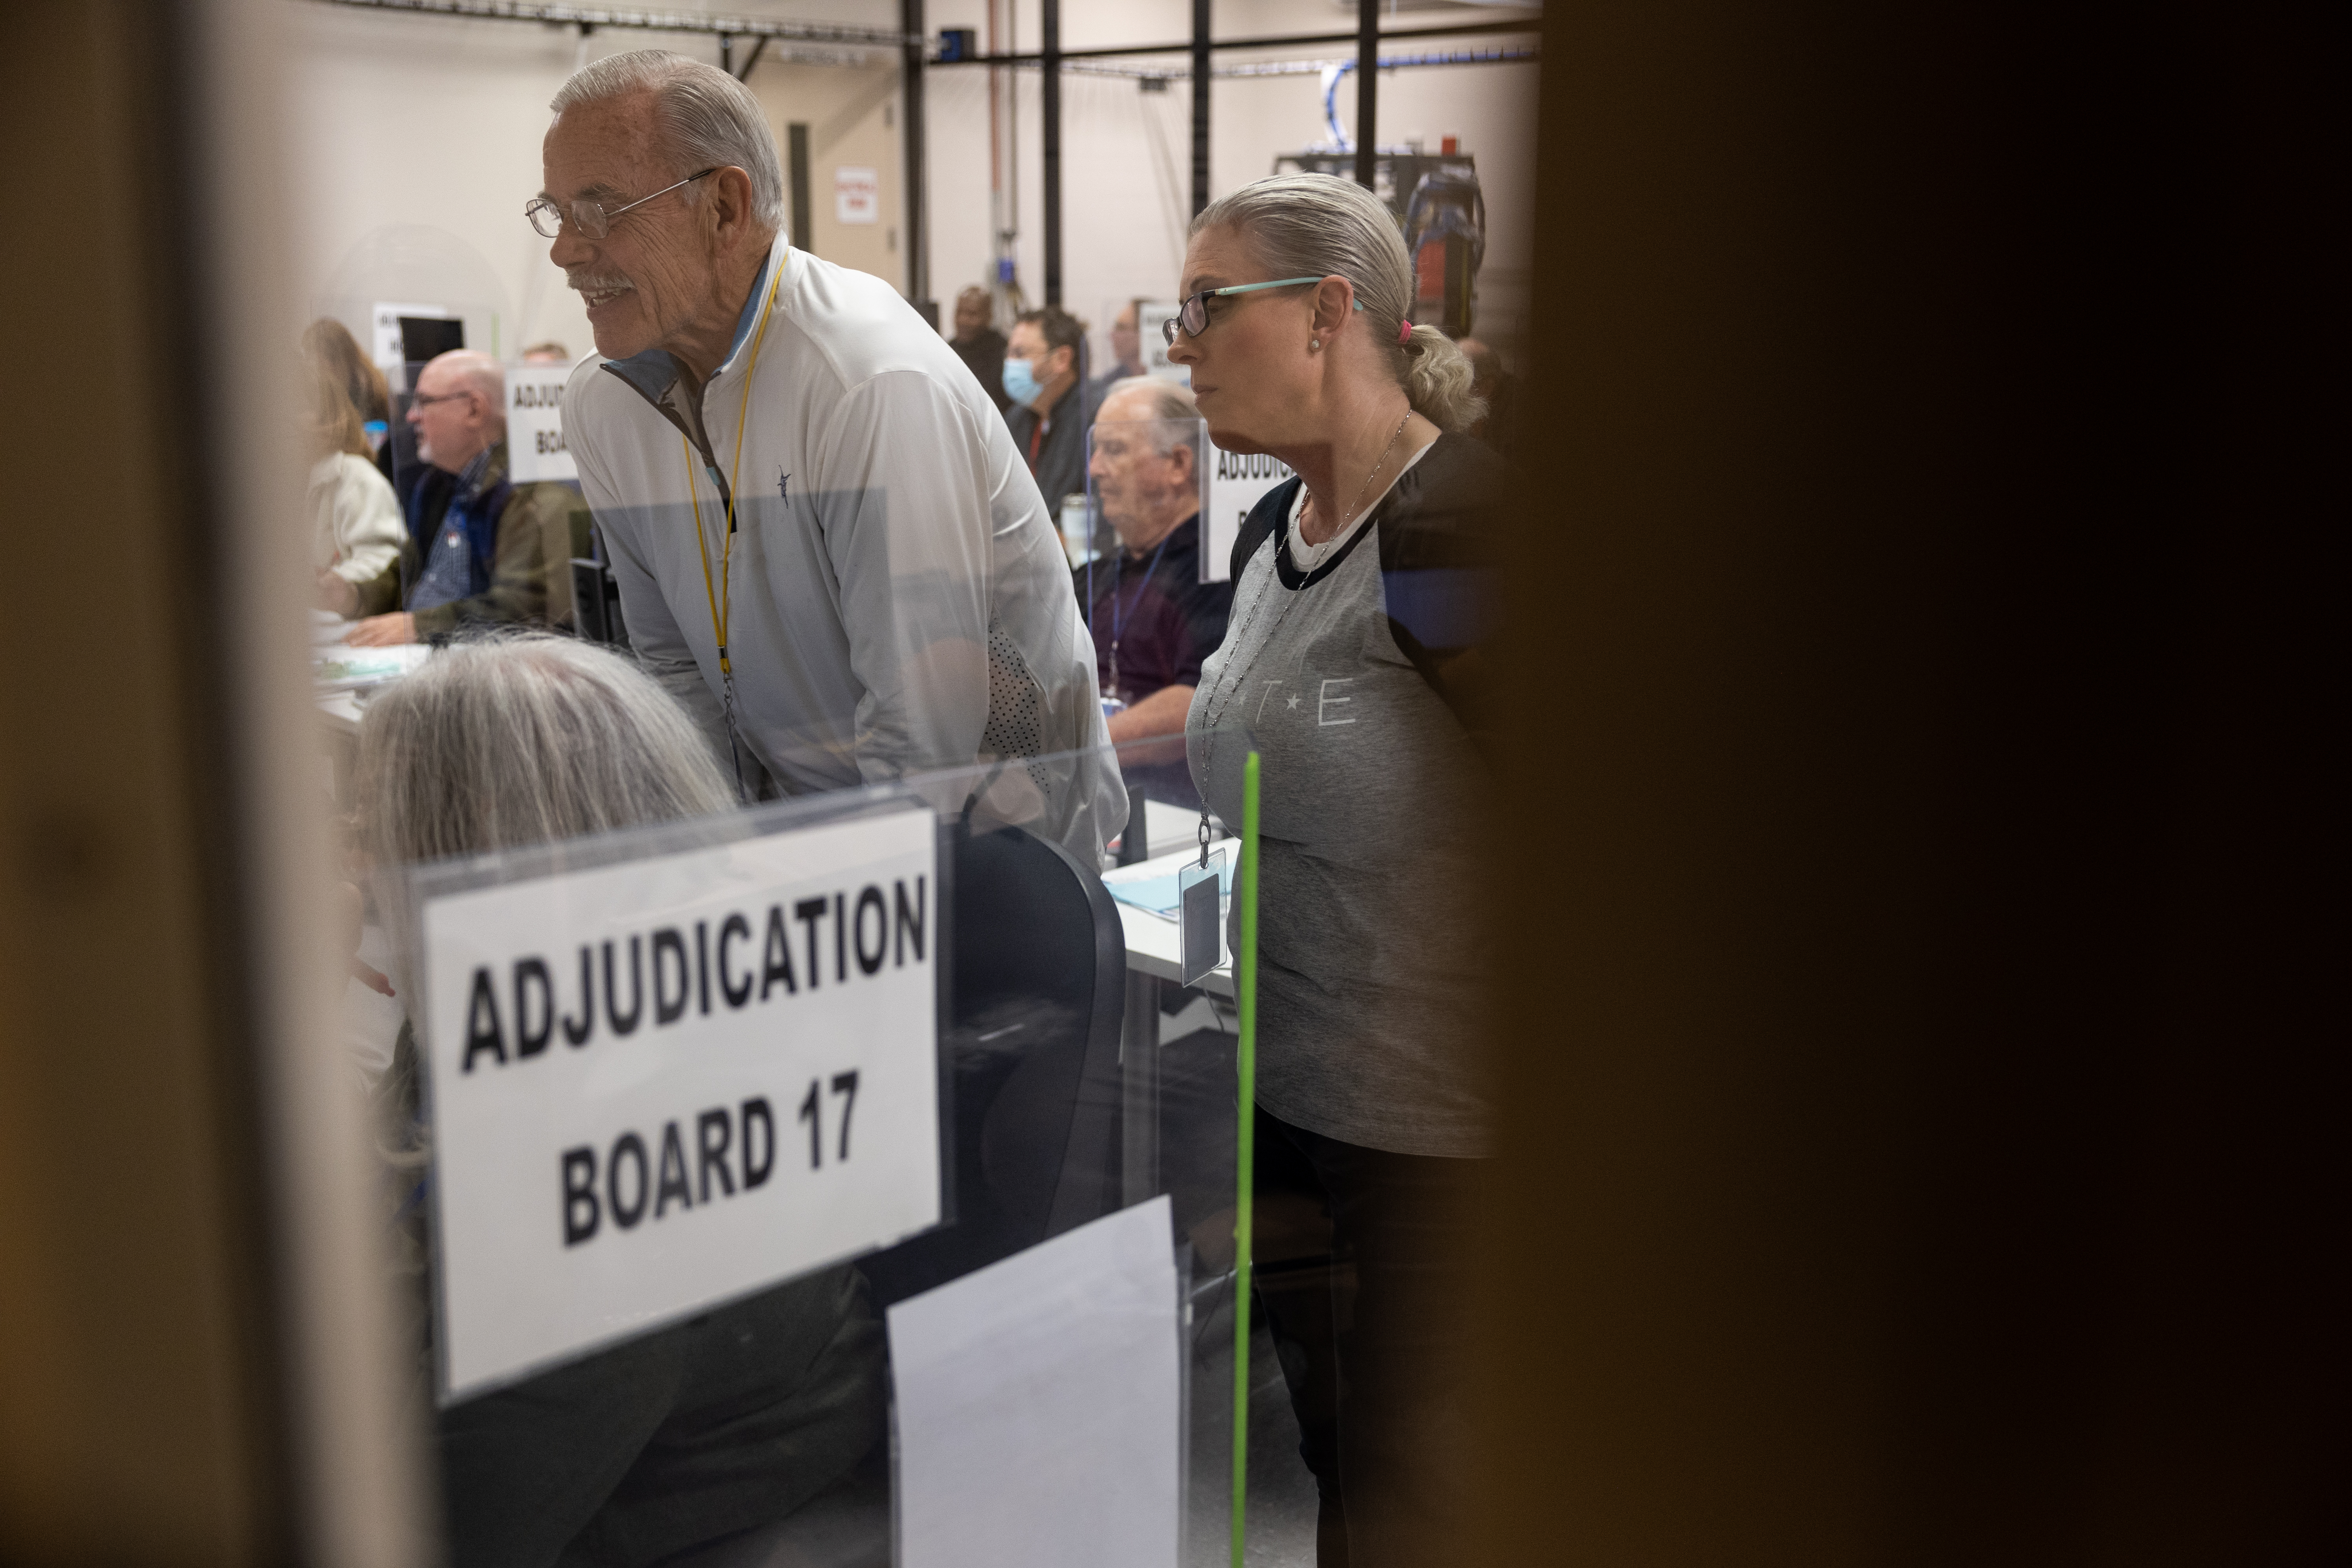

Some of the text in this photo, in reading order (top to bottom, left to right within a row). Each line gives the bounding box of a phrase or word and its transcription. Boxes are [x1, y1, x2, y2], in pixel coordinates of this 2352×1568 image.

[1217, 450, 1295, 480] ADJUDIC
[461, 875, 926, 1074] ADJUDICATION
[561, 1069, 859, 1247] BOARD 17
